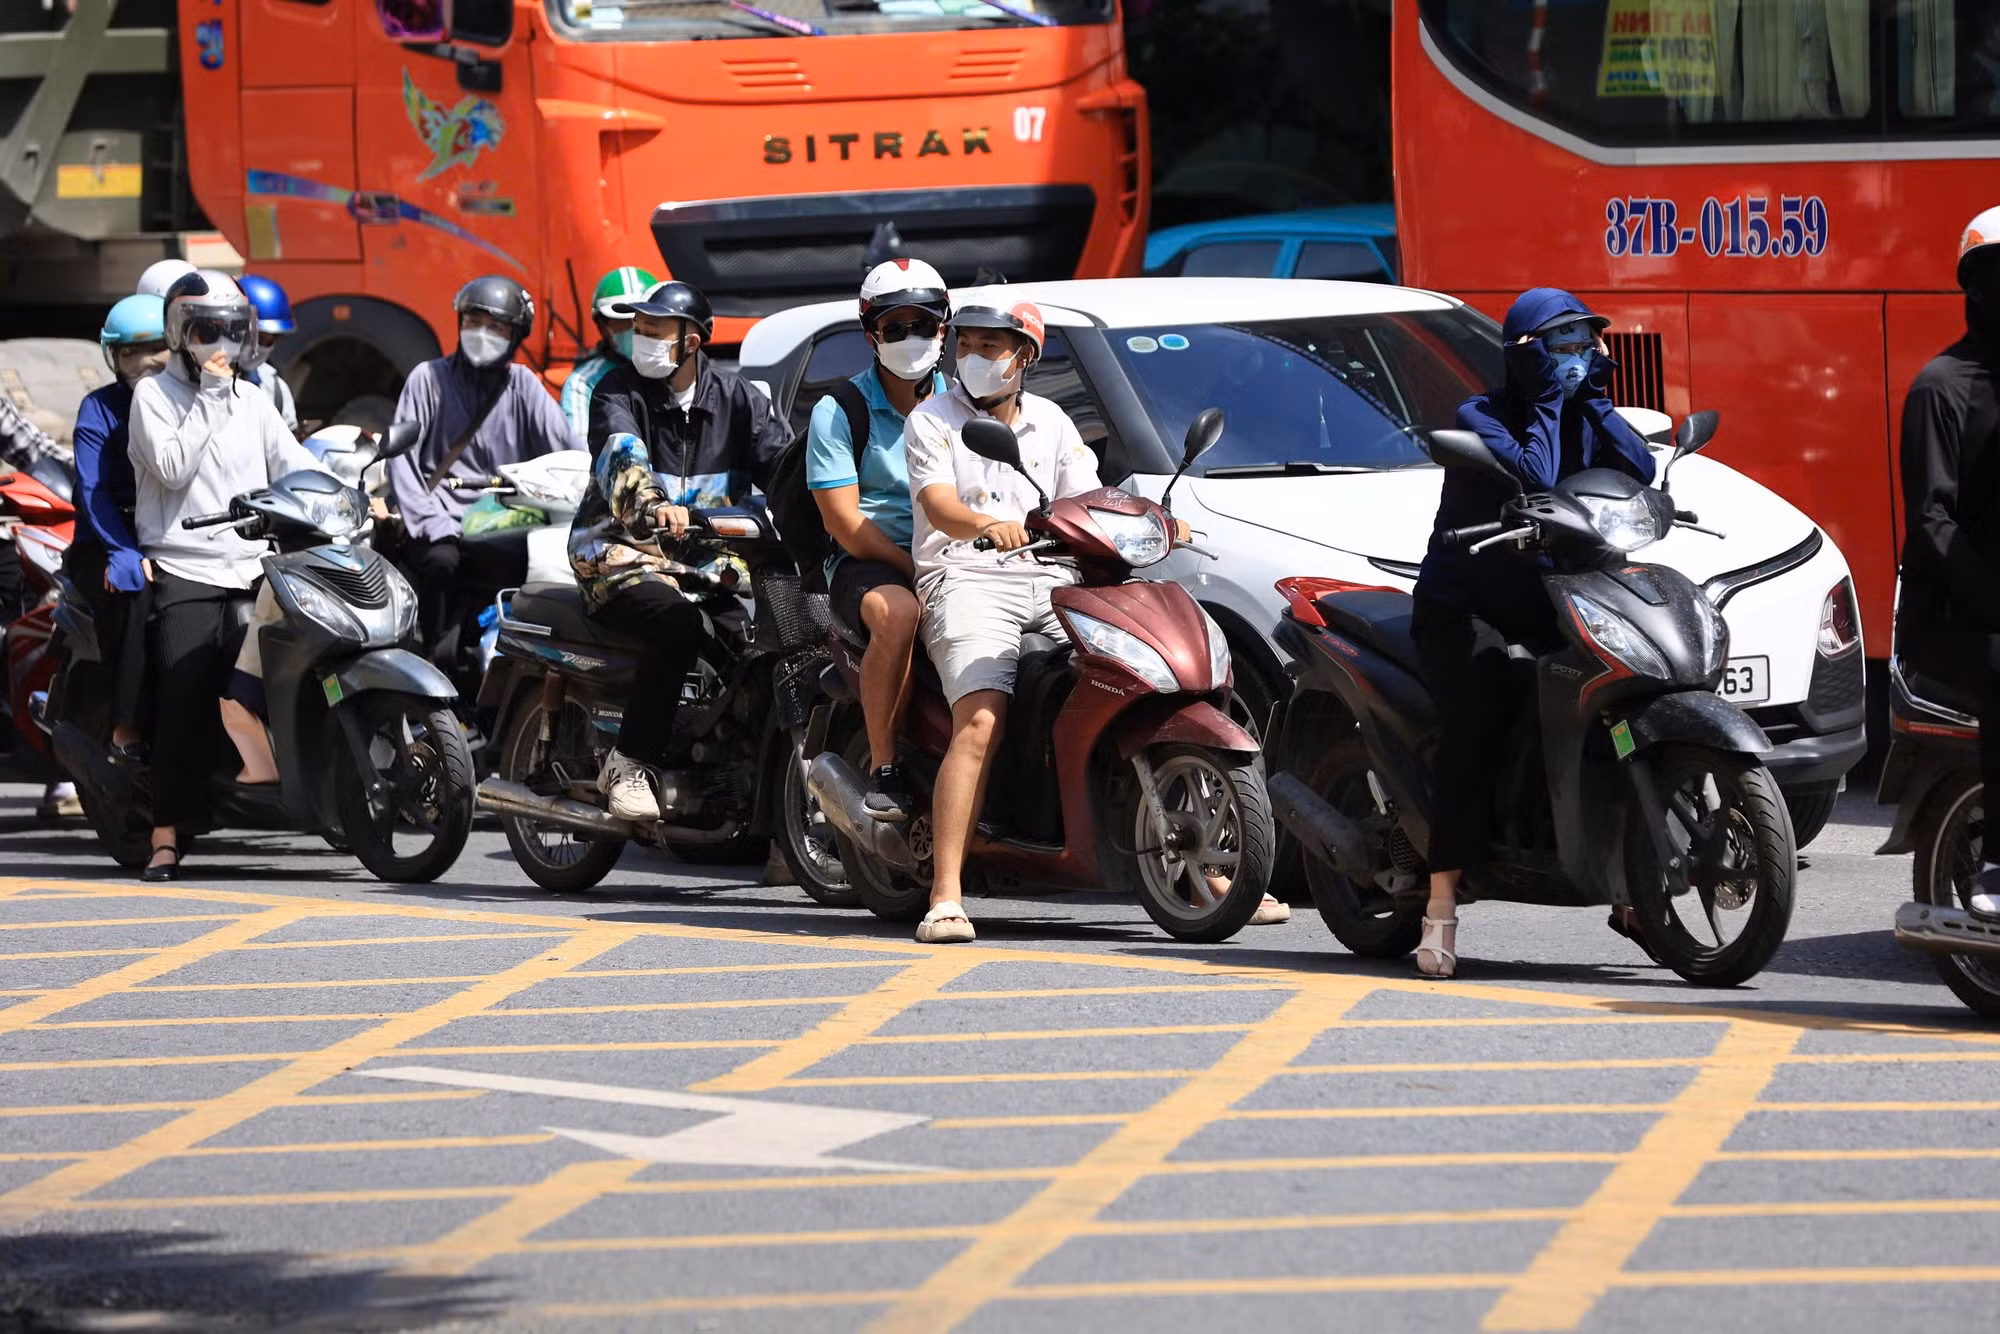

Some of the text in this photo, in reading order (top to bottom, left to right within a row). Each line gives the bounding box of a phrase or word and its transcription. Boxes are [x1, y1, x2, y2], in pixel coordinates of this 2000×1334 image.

[1013, 106, 1046, 142] 07
[763, 127, 992, 165] SITRAK
[1604, 194, 1829, 257] 37B-015.59
[1090, 679, 1126, 697] HONDA
[598, 709, 623, 719] HONDA
